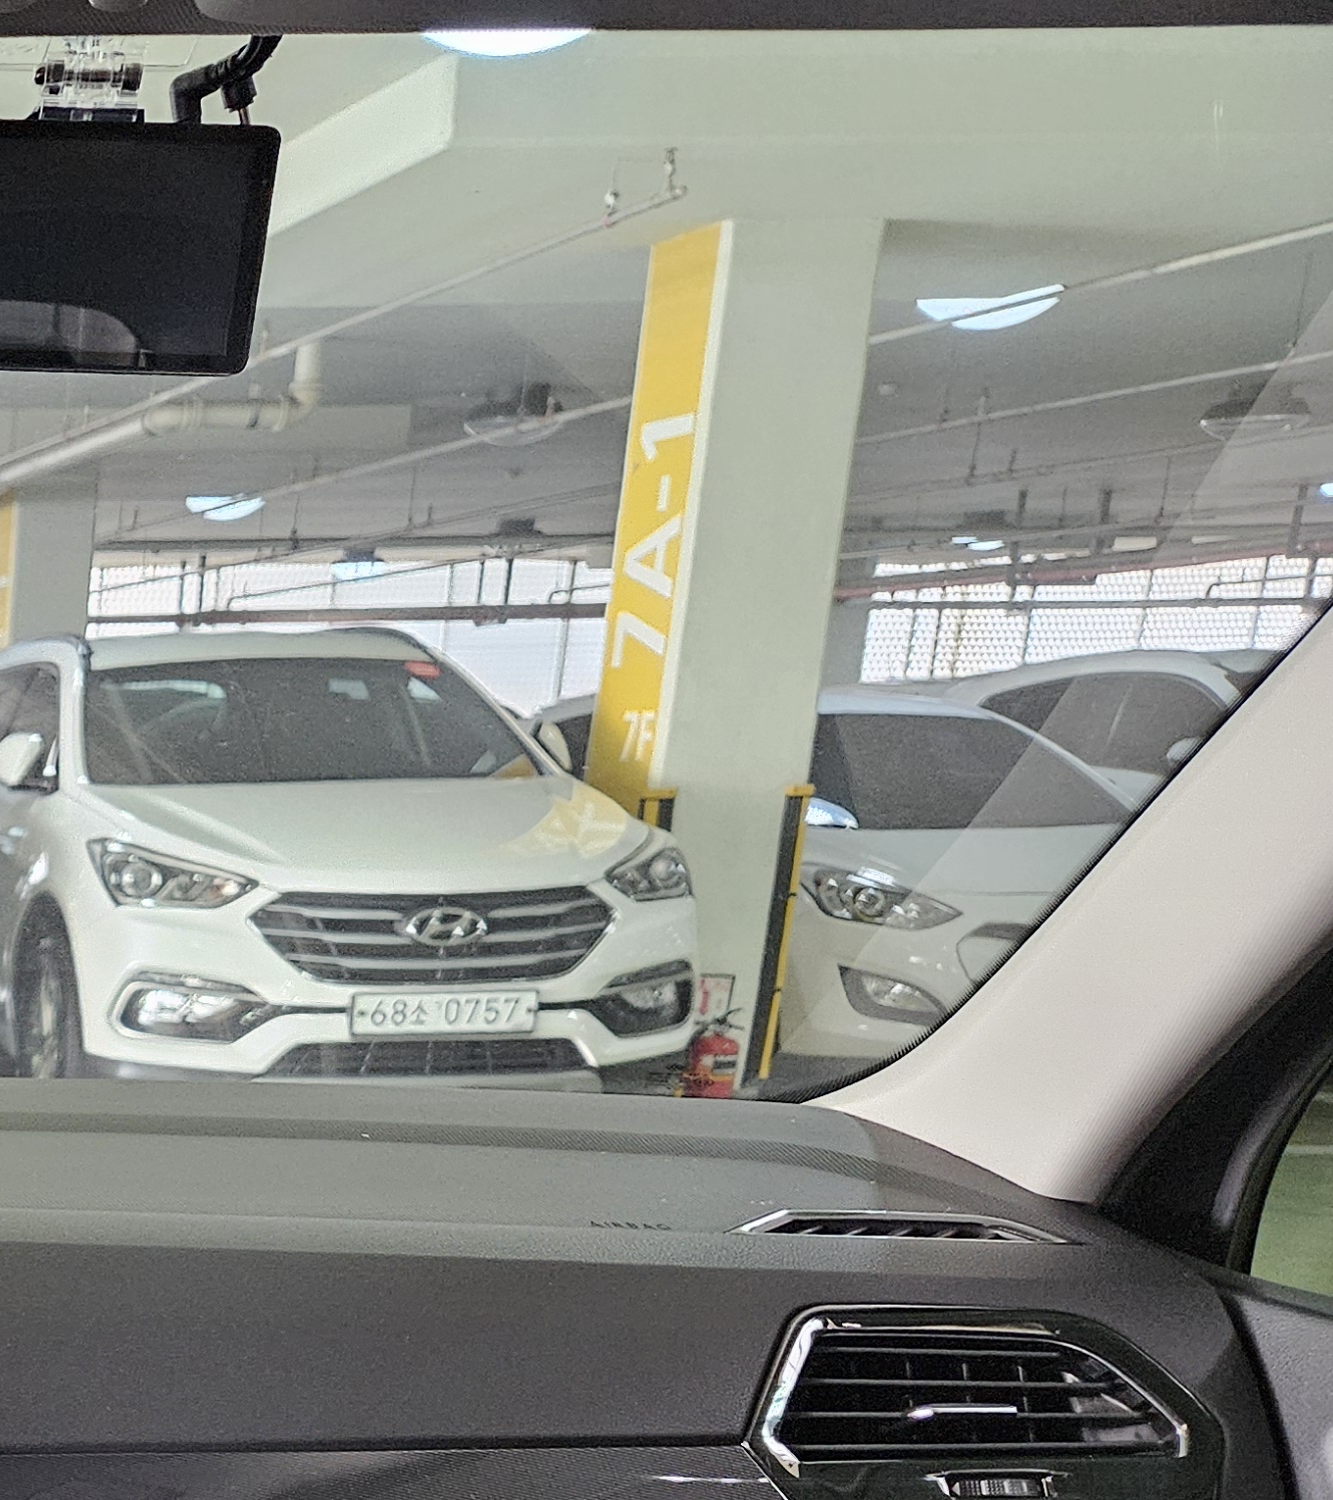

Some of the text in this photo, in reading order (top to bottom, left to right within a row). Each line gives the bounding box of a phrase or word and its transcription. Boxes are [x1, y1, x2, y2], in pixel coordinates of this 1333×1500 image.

[611, 412, 696, 669] 7A-1
[619, 710, 657, 763] 7F
[370, 996, 521, 1027] 68소 0757
